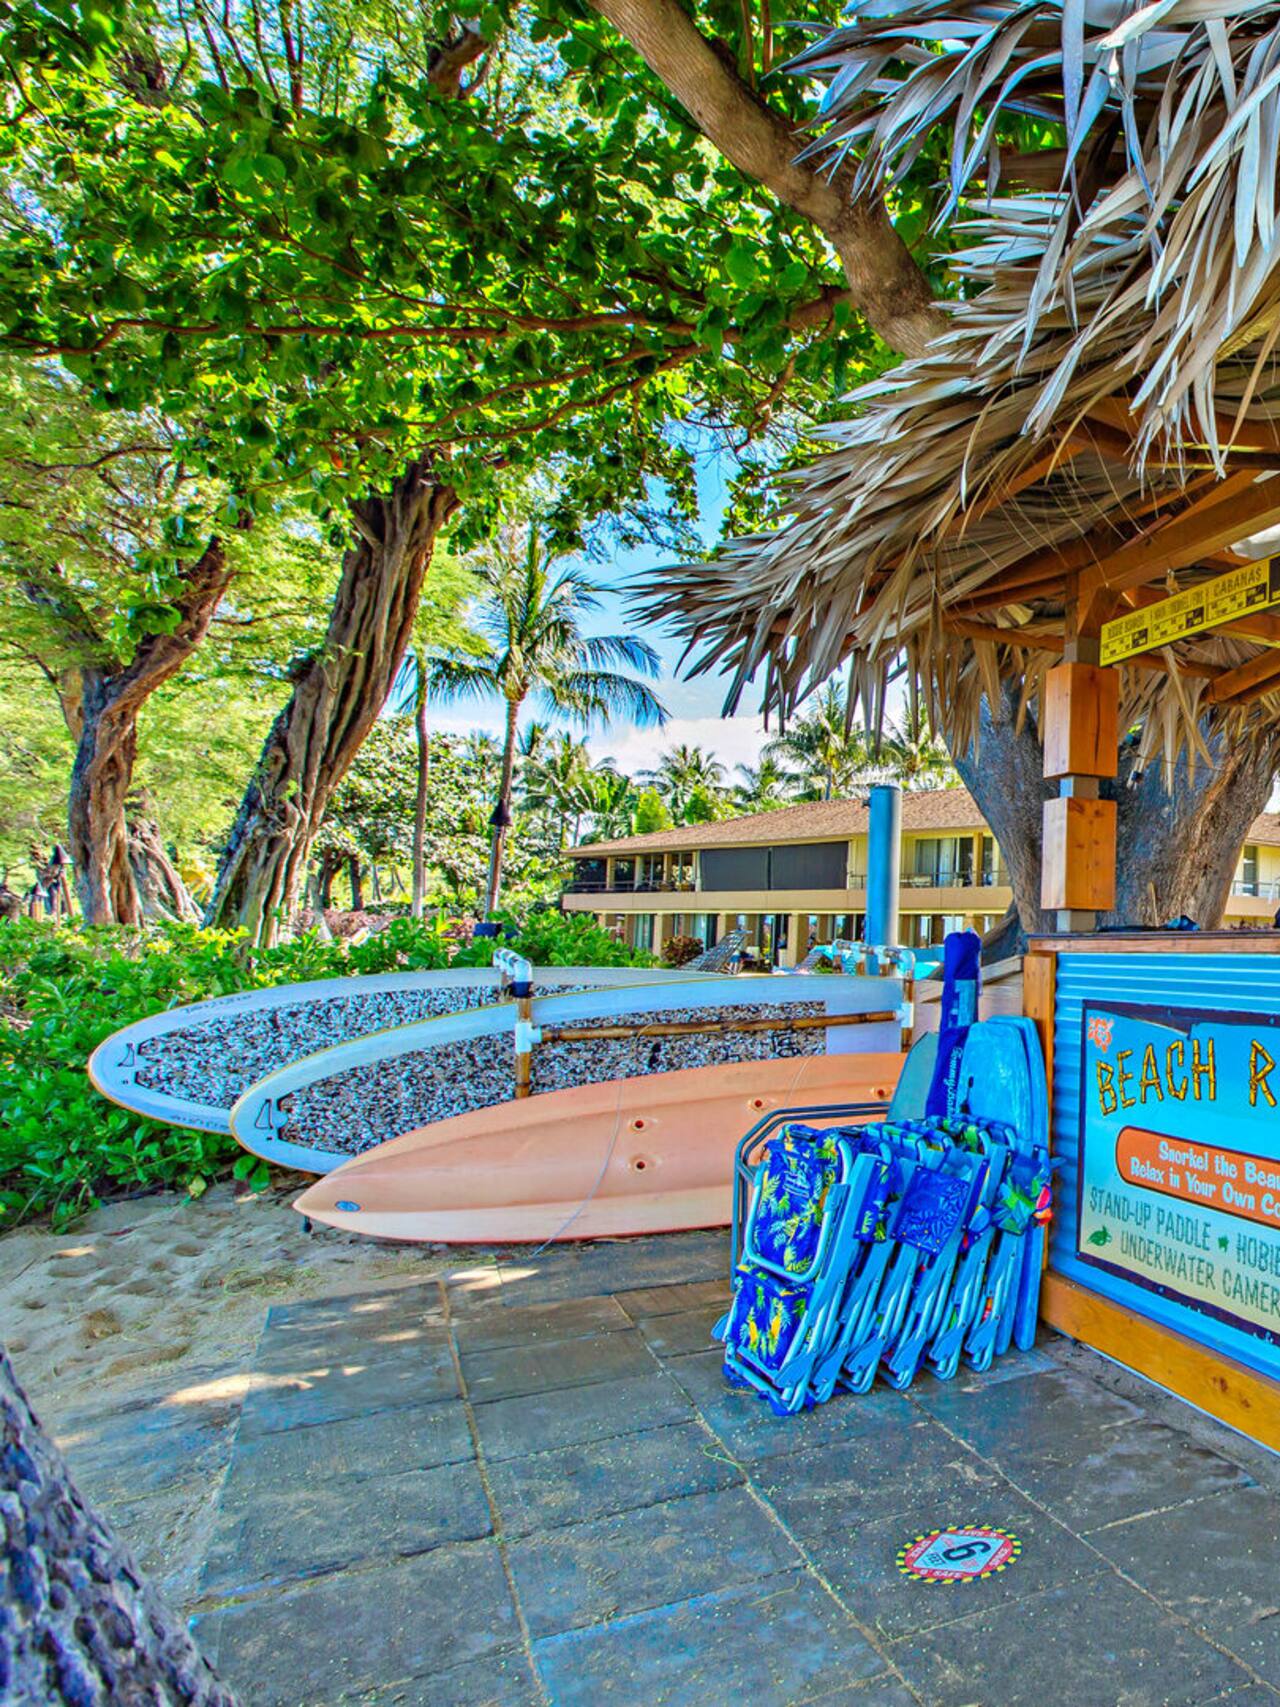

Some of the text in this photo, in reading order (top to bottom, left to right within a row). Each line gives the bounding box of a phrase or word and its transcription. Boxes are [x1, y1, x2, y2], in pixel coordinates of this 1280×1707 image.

[1213, 566, 1262, 599] CABANAS
[1095, 1037, 1217, 1117] BEACH
[1129, 1156, 1165, 1185] Relax
[1168, 1167, 1181, 1190] in
[1185, 1171, 1217, 1200] Your
[1221, 1182, 1257, 1211] Own
[1157, 1140, 1210, 1173] Snorkel
[1213, 1154, 1239, 1180] the
[1088, 1186, 1154, 1230] STAND-UP
[1156, 1206, 1212, 1252] PADDLE
[1119, 1230, 1217, 1292] UNDERWATER
